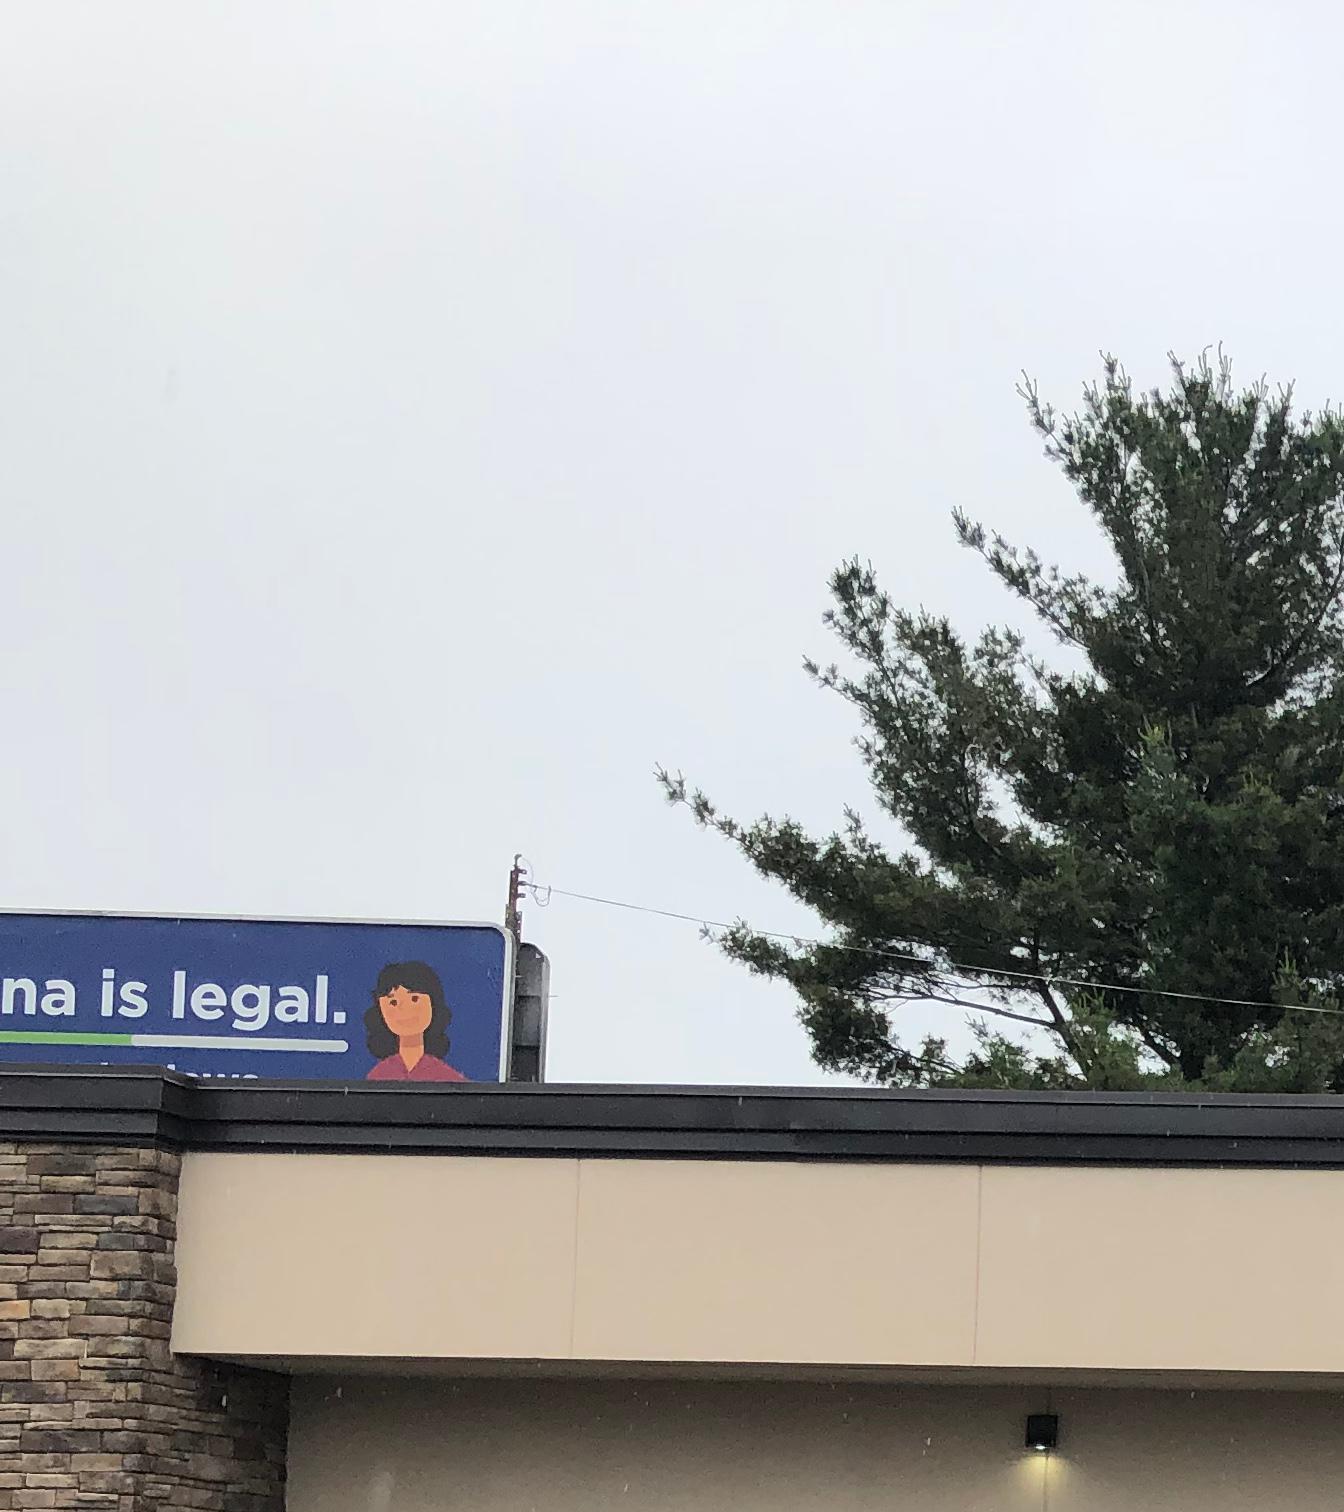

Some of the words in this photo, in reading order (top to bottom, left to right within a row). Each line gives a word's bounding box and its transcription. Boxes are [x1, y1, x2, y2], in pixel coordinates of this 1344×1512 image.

[1, 977, 76, 1016] na
[100, 968, 148, 1018] is
[172, 970, 346, 1032] legal.
